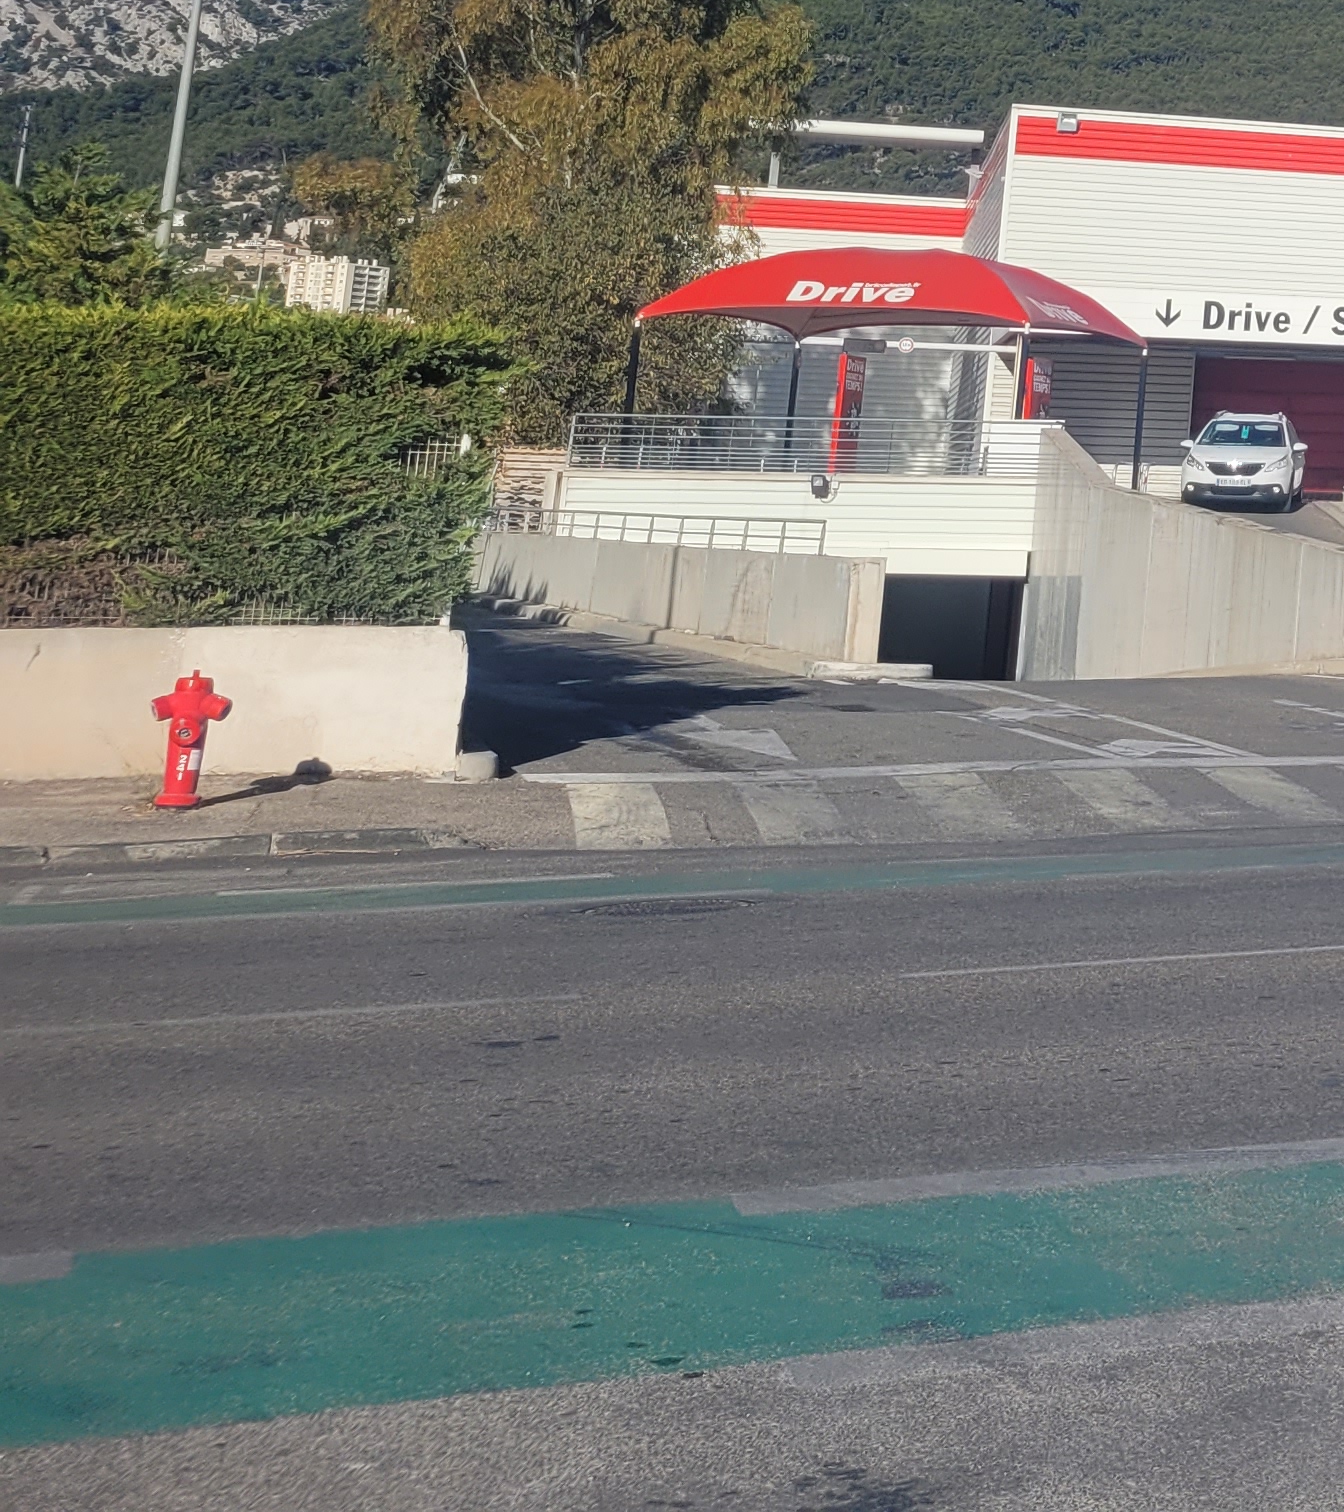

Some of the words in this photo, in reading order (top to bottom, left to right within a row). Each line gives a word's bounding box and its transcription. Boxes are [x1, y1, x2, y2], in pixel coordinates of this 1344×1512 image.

[786, 280, 915, 303] Drive
[1202, 300, 1291, 333] Drive
[1302, 305, 1322, 335] /
[176, 754, 188, 781] 241
